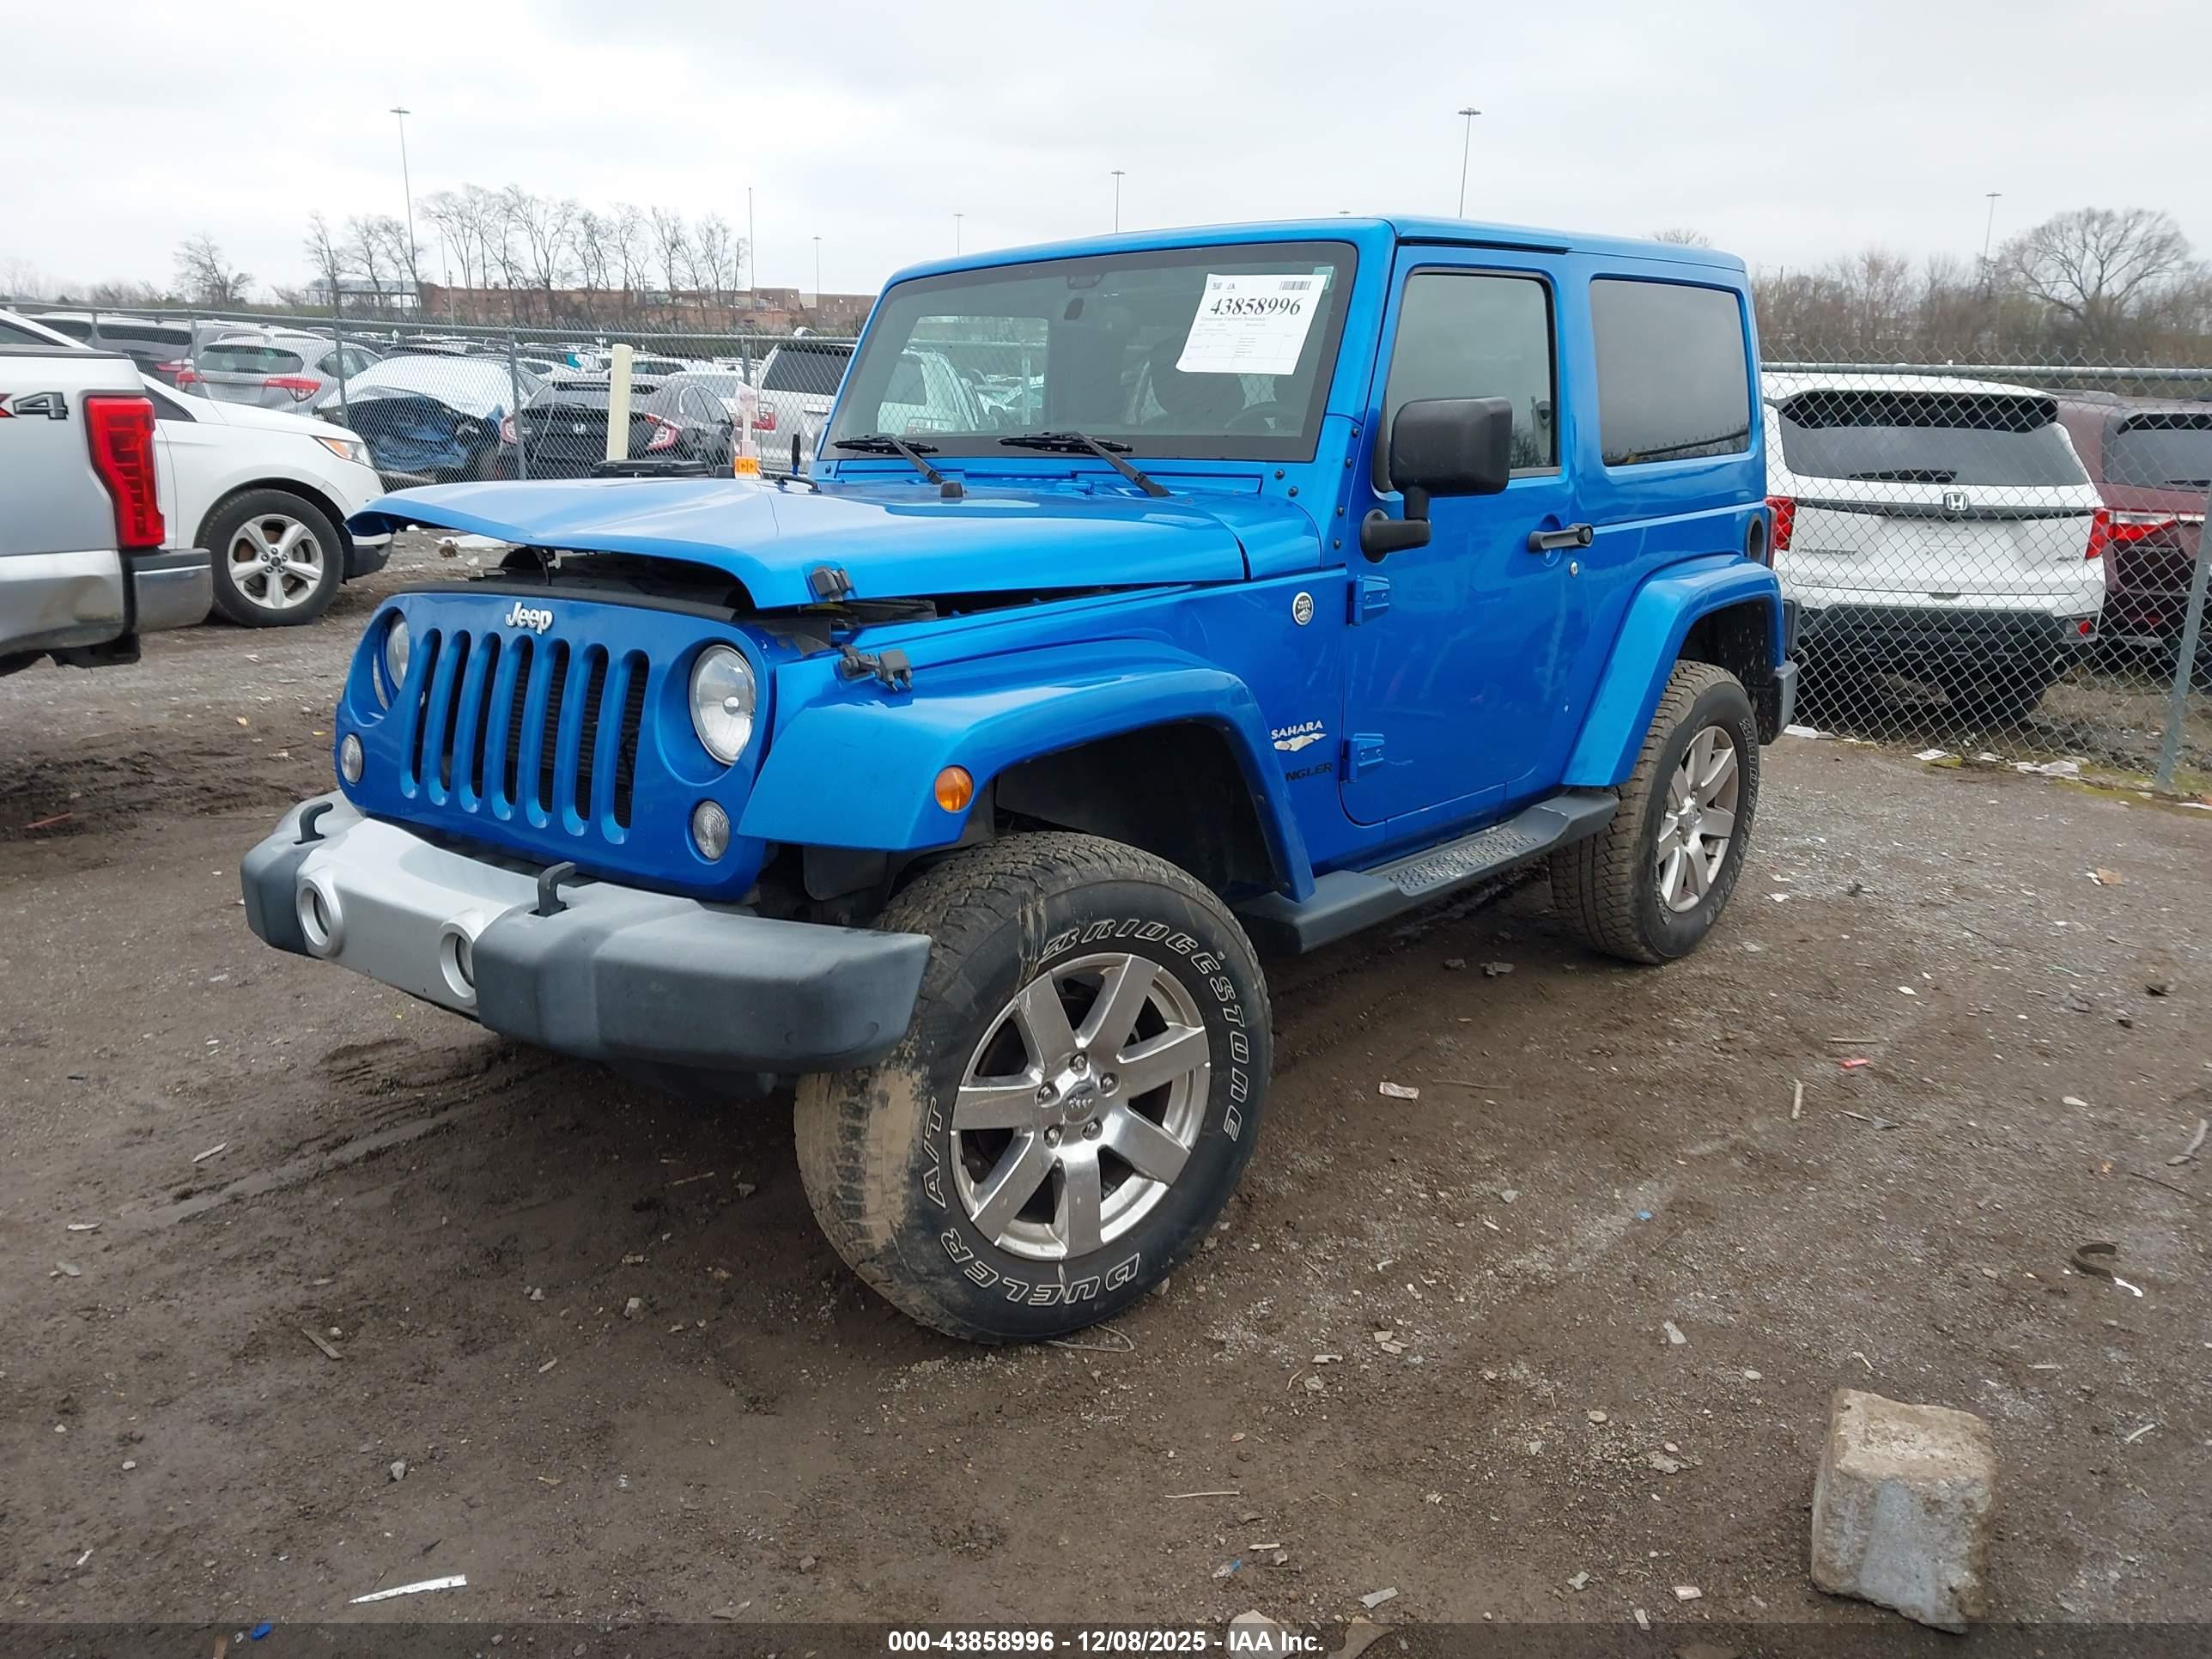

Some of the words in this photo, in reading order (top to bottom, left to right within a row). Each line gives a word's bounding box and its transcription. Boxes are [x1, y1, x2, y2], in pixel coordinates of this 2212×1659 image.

[1210, 296, 1304, 316] 43858996
[505, 601, 553, 635] Jeep
[1271, 720, 1324, 740] SAHARA
[1036, 918, 1249, 1143] BRIDGESTONE
[923, 1096, 946, 1209] A/T
[940, 1227, 1140, 1307] DUELER
